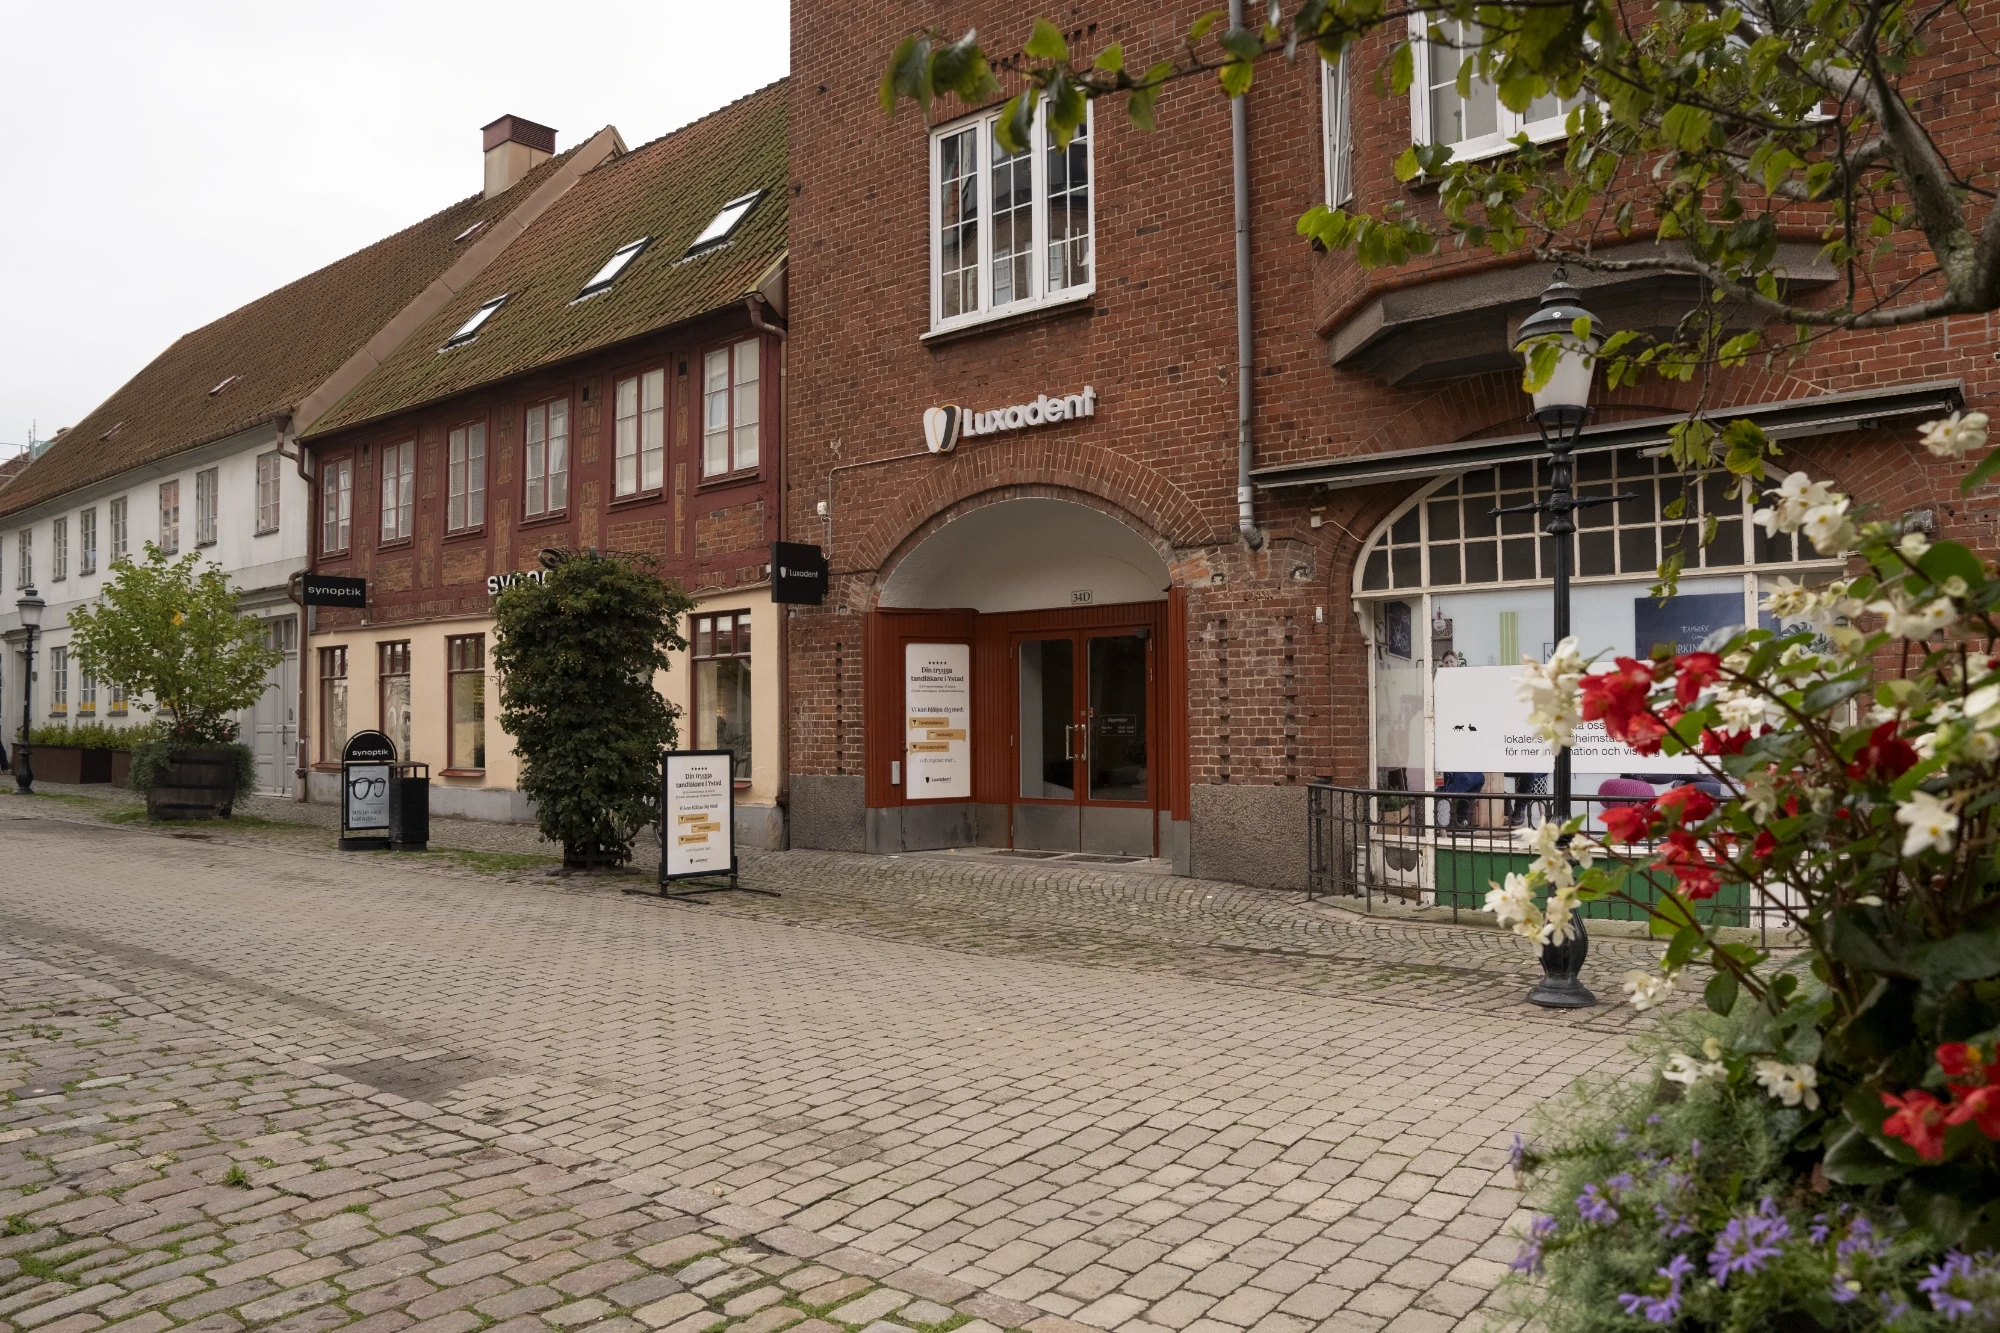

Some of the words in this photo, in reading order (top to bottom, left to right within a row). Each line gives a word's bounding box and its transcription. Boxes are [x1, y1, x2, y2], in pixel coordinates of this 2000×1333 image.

[963, 385, 1097, 437] Luxadent
[790, 569, 818, 578] Luxadent
[308, 587, 361, 596] synoptik
[1073, 592, 1090, 602] 34D
[1680, 625, 1709, 633] TEAMWORK
[1587, 722, 1605, 730] oss
[1505, 747, 1518, 756] för
[1601, 747, 1620, 756] och
